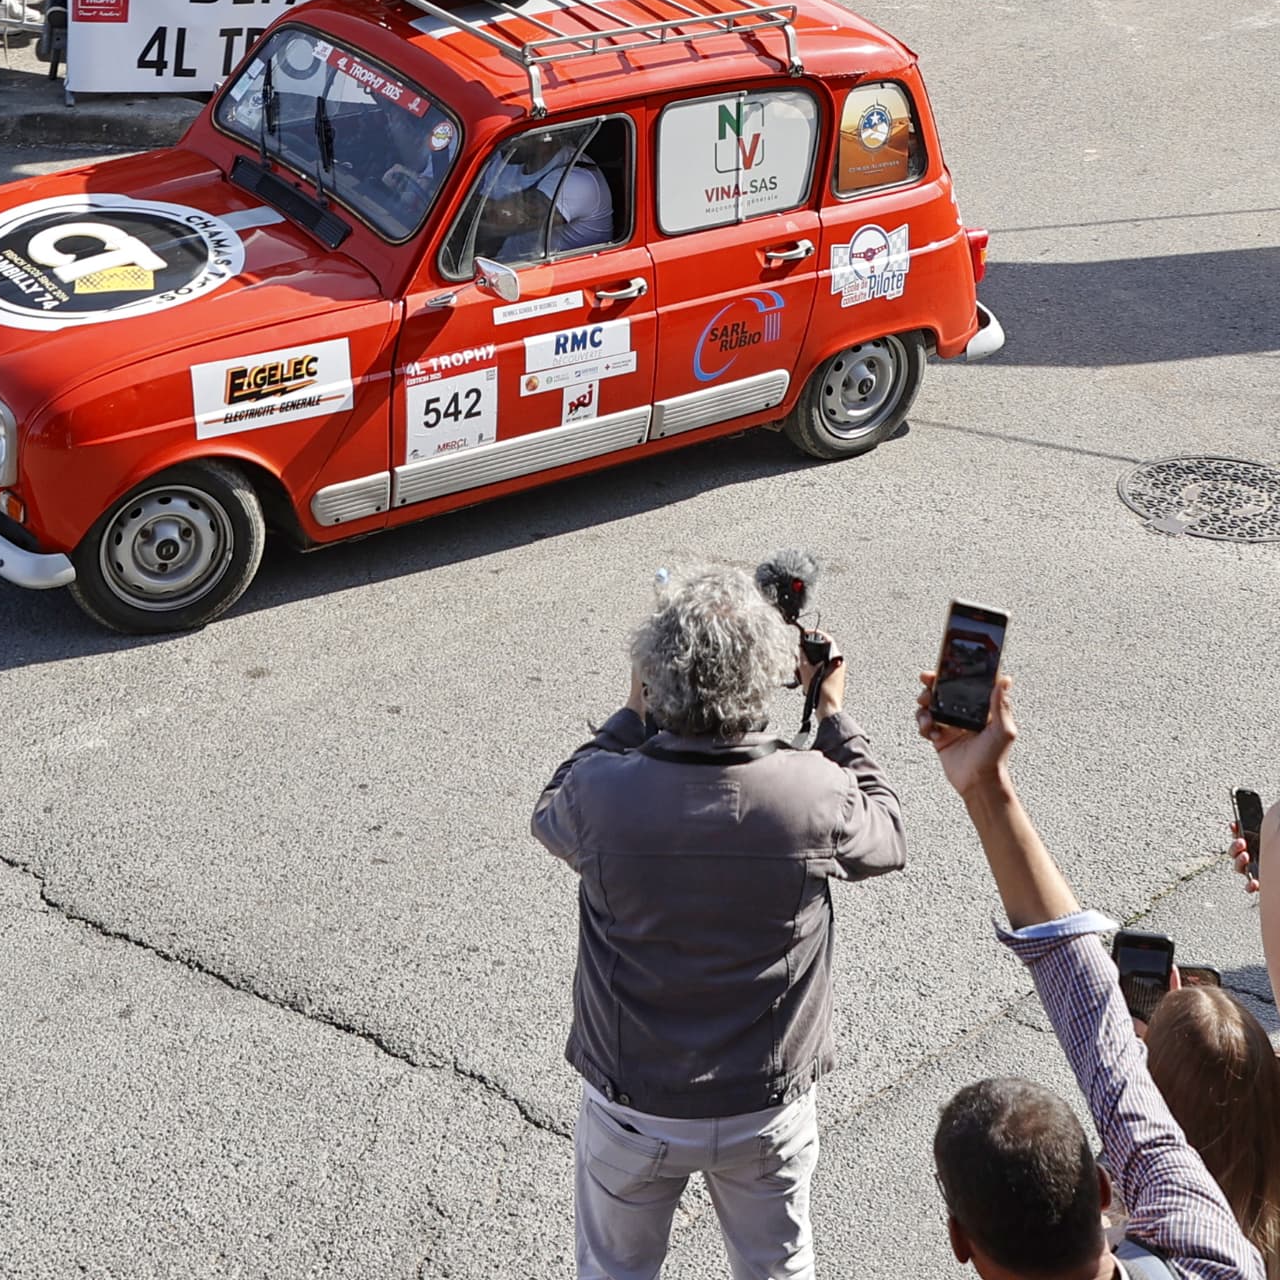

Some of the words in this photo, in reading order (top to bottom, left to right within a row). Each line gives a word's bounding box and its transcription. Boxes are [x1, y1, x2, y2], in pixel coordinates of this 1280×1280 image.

[136, 26, 198, 78] 4L
[337, 57, 349, 71] 4L
[348, 63, 386, 90] TROPHY
[380, 82, 404, 101] 2025
[184, 215, 233, 267] CHAMAS
[867, 271, 904, 299] Pilote
[34, 292, 61, 310] 74
[554, 326, 604, 356] RMC
[709, 320, 749, 343] SARL
[719, 331, 762, 353] RUBIO
[405, 361, 426, 377] 4L
[429, 343, 497, 372] TROPHY
[223, 402, 276, 424] ELECTRICITE
[278, 394, 323, 414] GENERALE
[423, 387, 483, 430] 542
